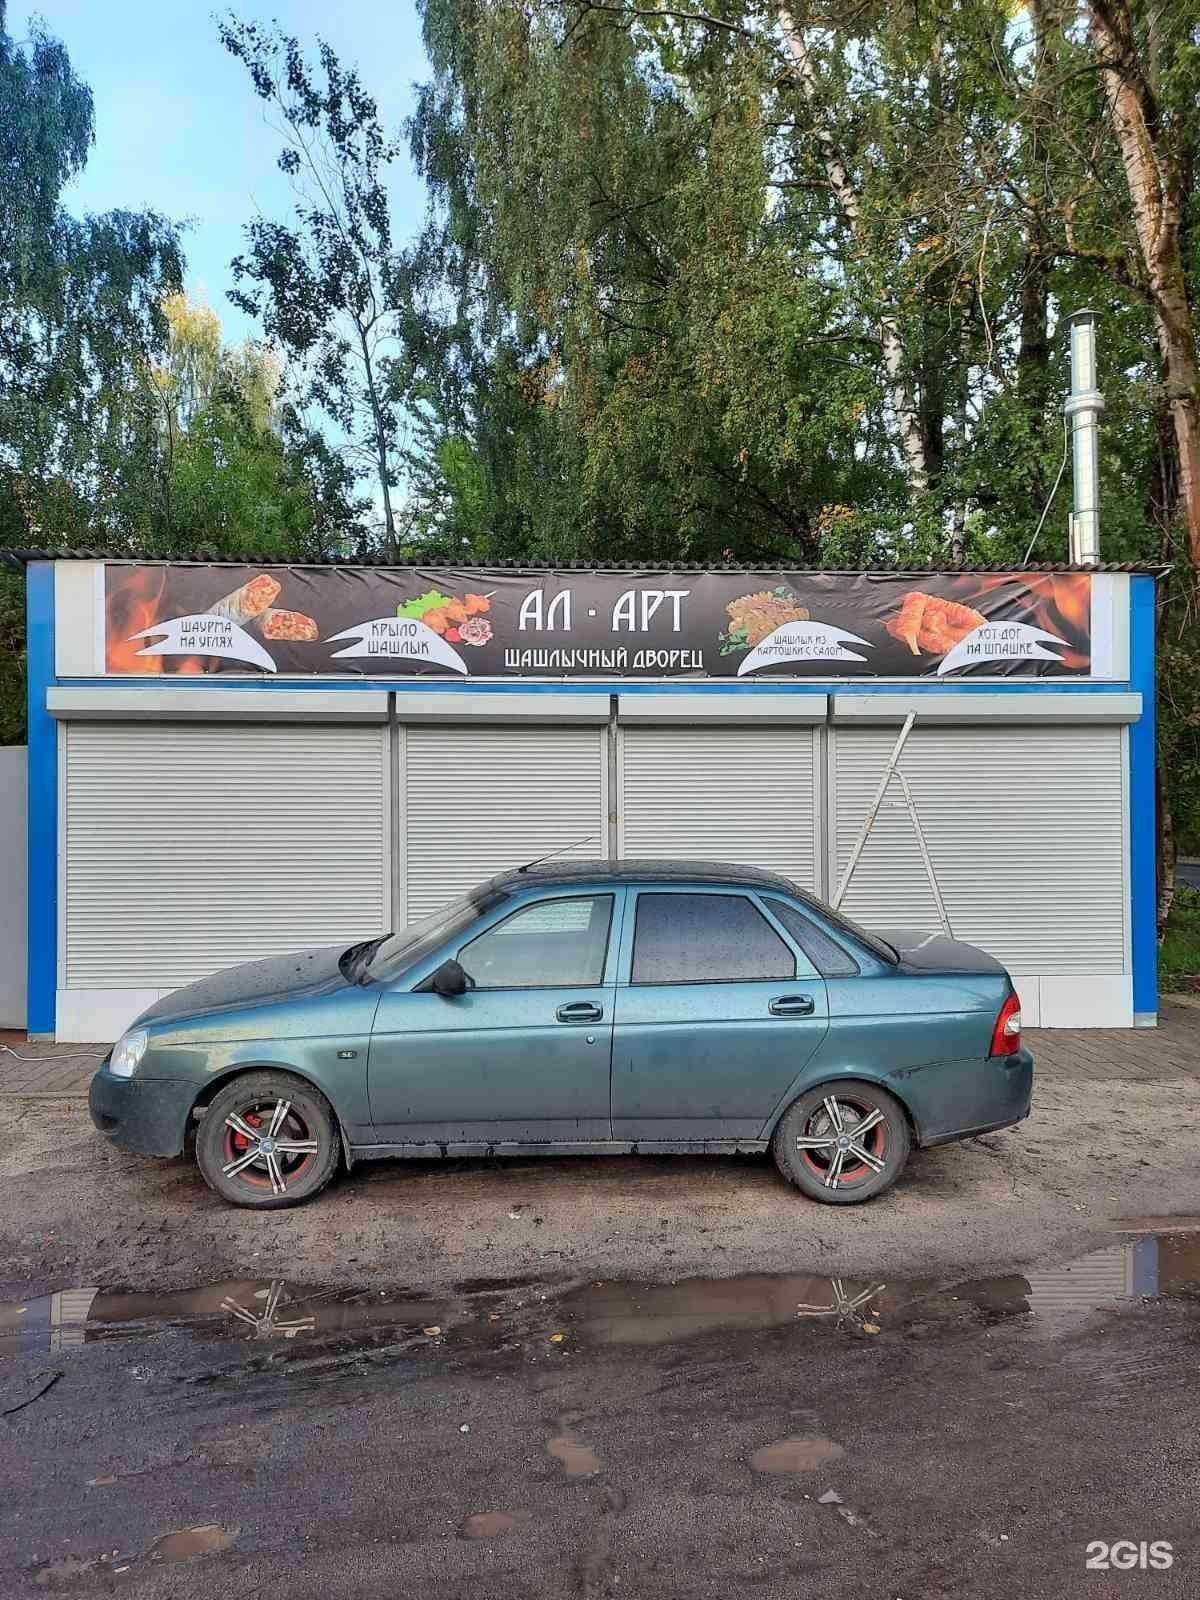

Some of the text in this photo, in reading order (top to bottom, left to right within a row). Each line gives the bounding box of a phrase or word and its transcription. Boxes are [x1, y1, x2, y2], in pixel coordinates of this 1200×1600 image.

[518, 589, 571, 631] АЛ
[611, 590, 690, 632] АРТ
[181, 621, 232, 633] ШАУРМА
[371, 623, 417, 637] КРЫЛО
[774, 635, 826, 645] ШАШЛЫК ИЗ
[977, 628, 1022, 640] ХОТ ДОГ
[180, 636, 233, 648] НА УГЛЯХ
[368, 640, 430, 655] ШАШЛЫК
[757, 646, 843, 656] КАРТОШКИ С САЛОМ
[967, 643, 981, 655] НА
[504, 648, 704, 669] ШАШЛЫЧНЫЙ ДВОРЕЦ
